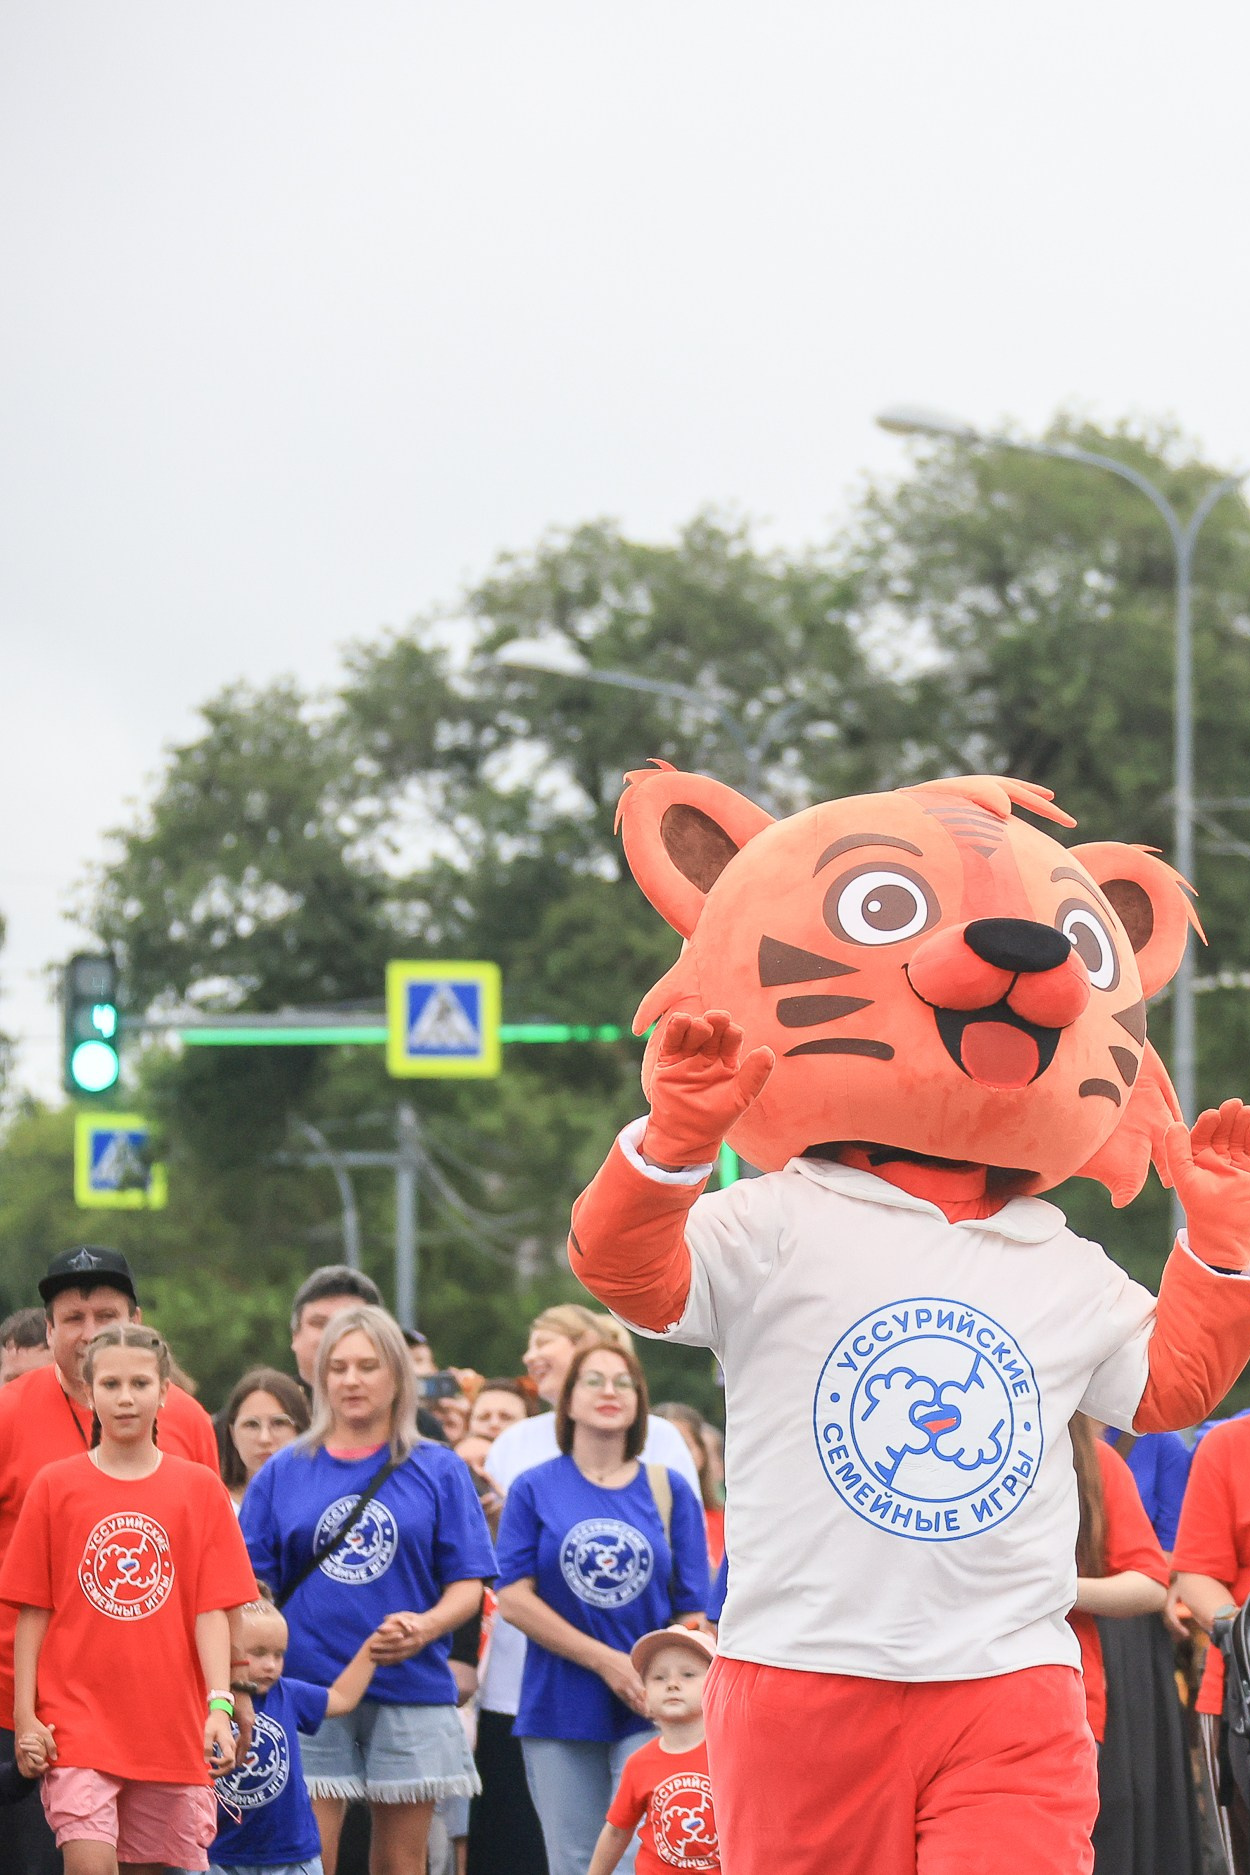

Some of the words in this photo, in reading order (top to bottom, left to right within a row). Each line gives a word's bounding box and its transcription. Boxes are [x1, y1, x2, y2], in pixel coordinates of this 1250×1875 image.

[837, 1308, 1031, 1398] УССУРИЙСКИЕ
[823, 1422, 961, 1533] СЕМЕЙНЫЕ
[971, 1449, 1035, 1523] ИГРЫ
[88, 1516, 169, 1554] УССУРИЙСКИЕ
[83, 1571, 143, 1617] СЕМЕЙНЫЕ
[144, 1574, 170, 1611] ИГРЫ
[654, 1775, 711, 1812] УССУРИЙС
